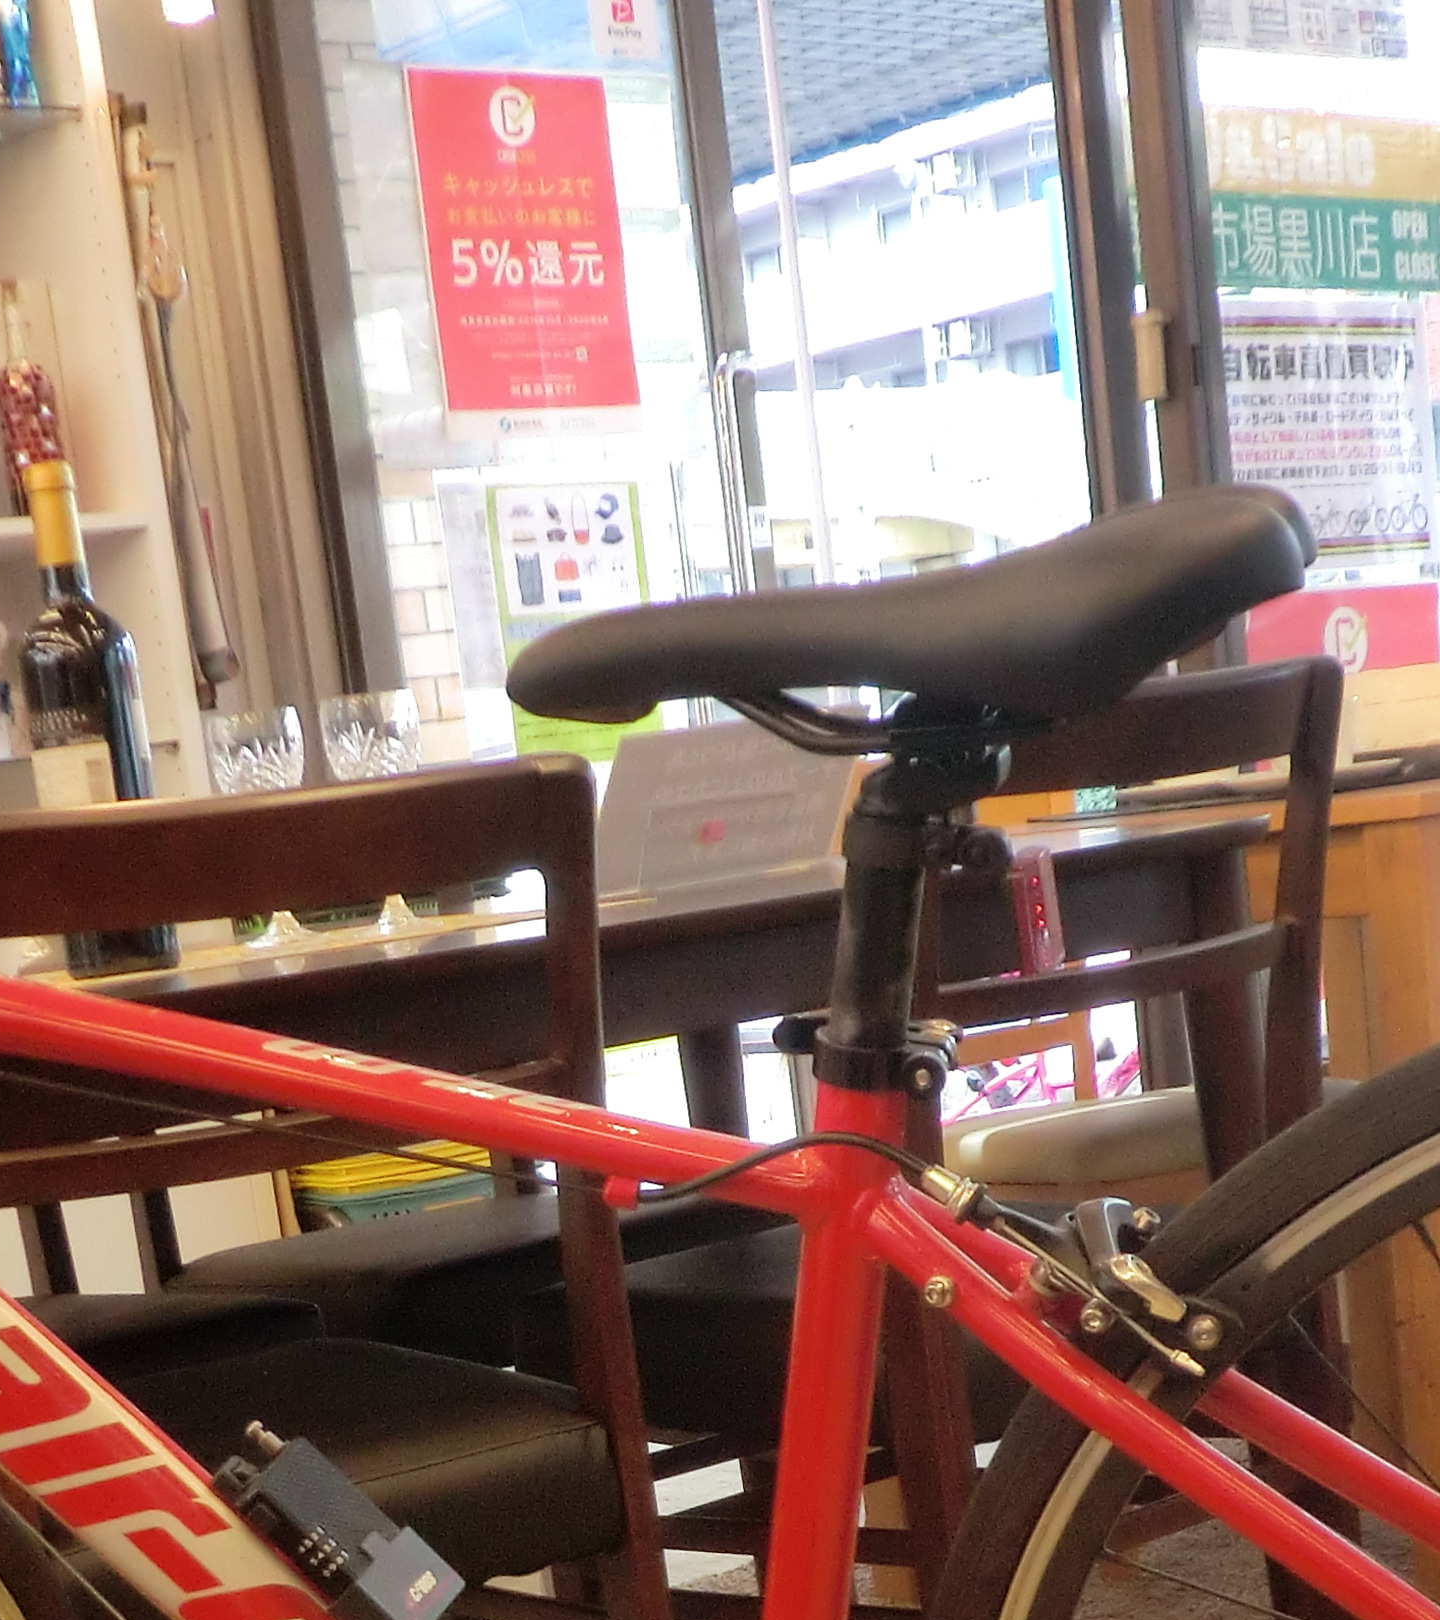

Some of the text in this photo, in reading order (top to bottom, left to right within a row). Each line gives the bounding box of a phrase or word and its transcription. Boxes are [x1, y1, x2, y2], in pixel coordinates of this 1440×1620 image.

[442, 171, 594, 198] キャッシュレスで
[1390, 209, 1430, 241] OPEN
[451, 238, 606, 288] 5%還元
[1394, 250, 1439, 282] CLOSE
